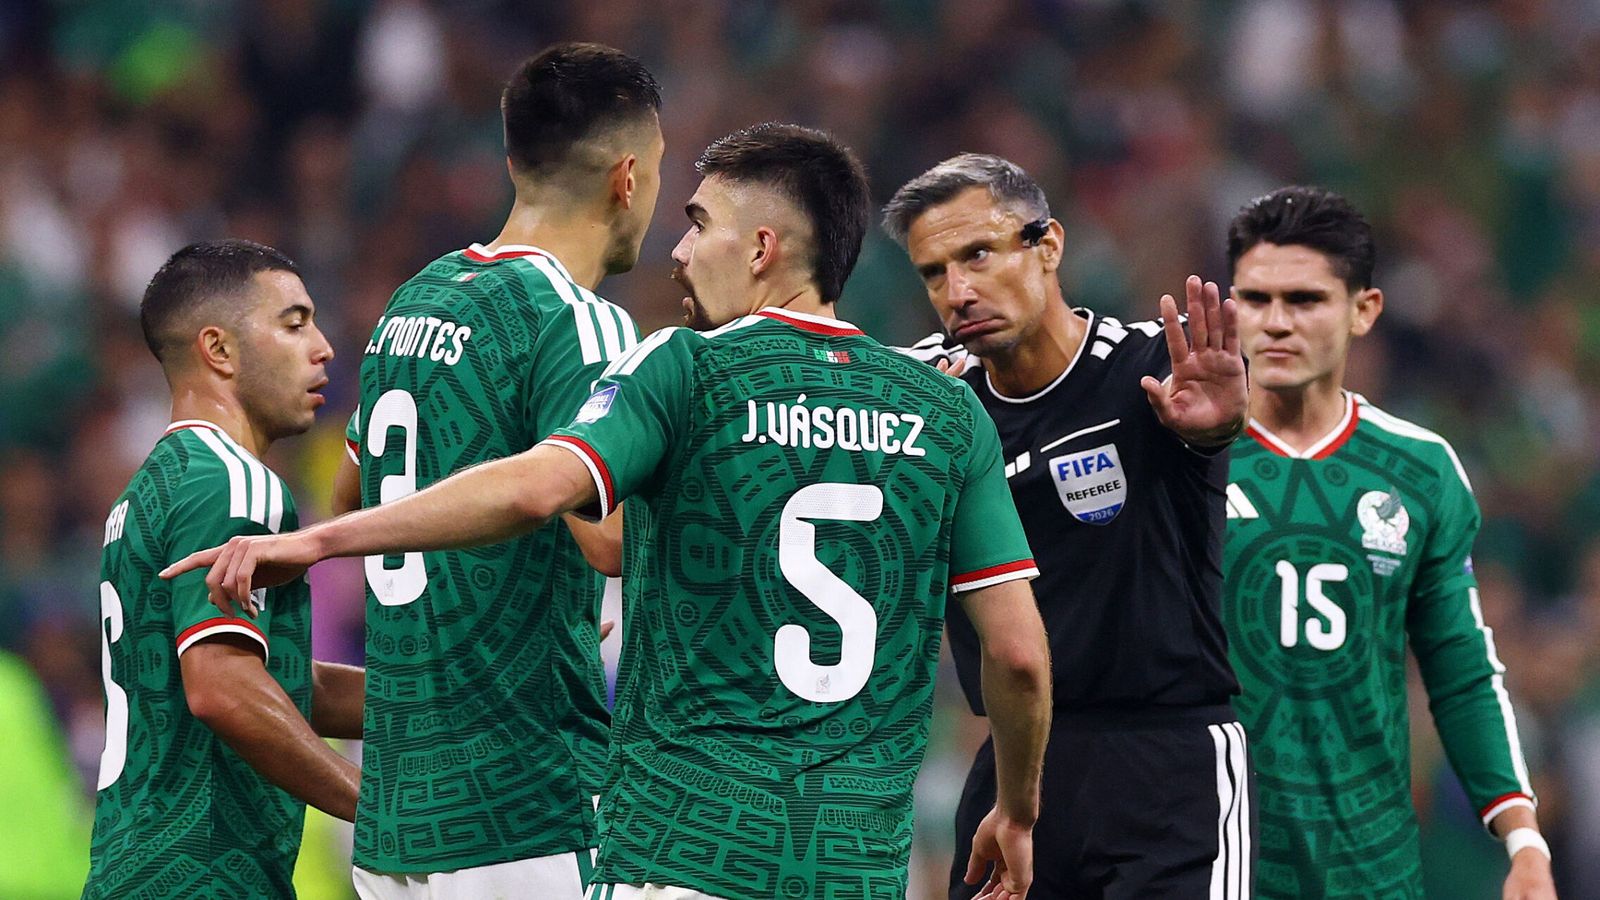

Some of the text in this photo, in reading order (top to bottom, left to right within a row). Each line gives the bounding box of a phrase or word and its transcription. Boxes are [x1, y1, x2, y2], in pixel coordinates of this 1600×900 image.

[741, 393, 926, 457] J.VÁSQUEZ
[1057, 452, 1115, 482] FIFA
[1066, 479, 1122, 502] REFEREE
[1088, 508, 1115, 521] 2026
[774, 482, 884, 703] 5
[1275, 559, 1349, 651] 15
